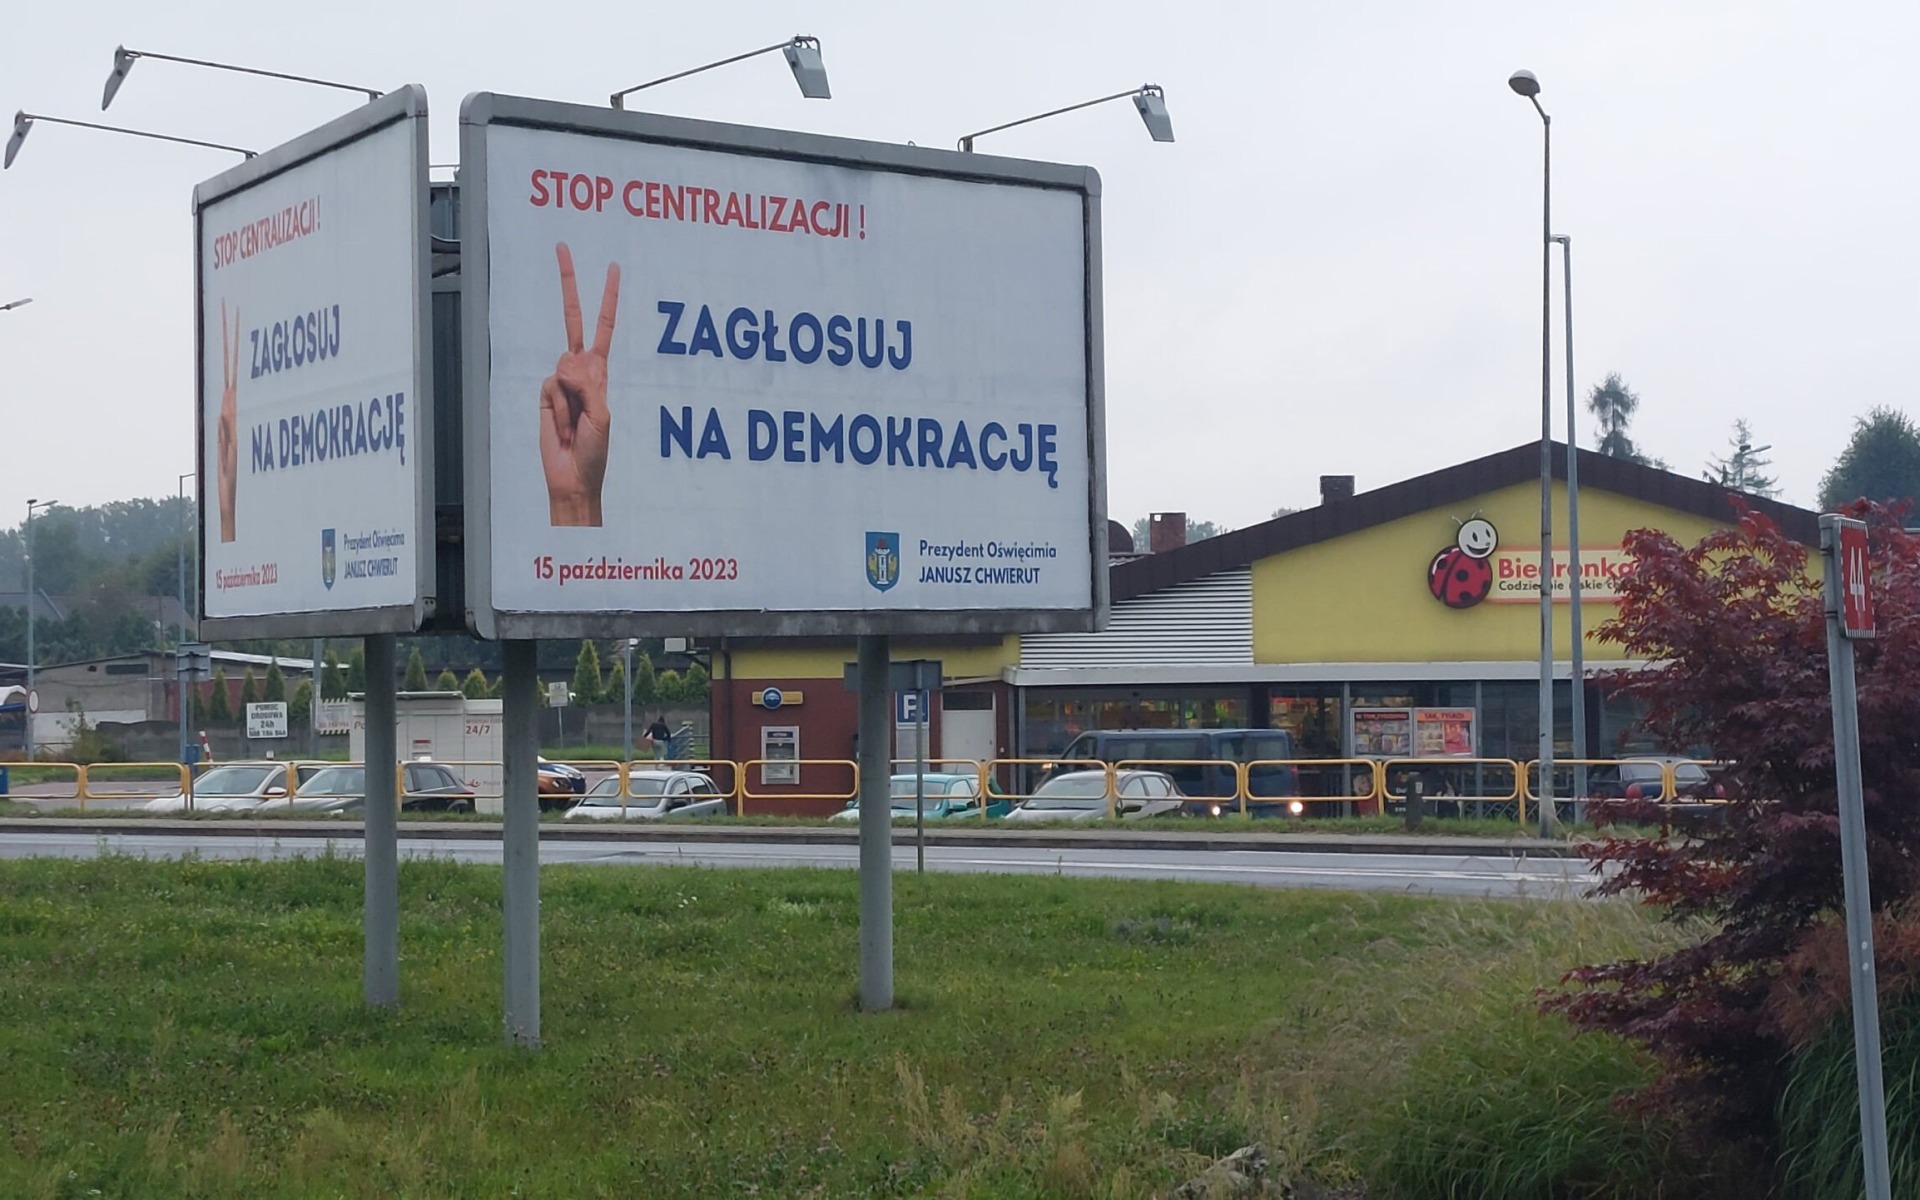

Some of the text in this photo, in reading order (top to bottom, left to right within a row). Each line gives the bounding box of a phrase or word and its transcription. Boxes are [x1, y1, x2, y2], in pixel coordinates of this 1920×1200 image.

[530, 169, 866, 240] STOP CENTRALIZACJI !
[214, 230, 239, 270] STOP
[240, 198, 315, 259] CENTRALIZACJI
[251, 304, 340, 379] ZAGŁOSUJ
[657, 301, 912, 370] ZAGŁOSUJ
[252, 392, 405, 474] NA DEMOKRACJĘ
[660, 405, 1059, 489] NA DEMOKRACJĘ
[344, 531, 372, 555] Prezydent
[919, 540, 1057, 562] Prezydent Oświęcimia
[215, 569, 223, 589] 15
[262, 563, 278, 585] 2023
[344, 560, 366, 579] JANUSZ
[533, 556, 738, 586] 15 października 2023
[919, 566, 1040, 584] JANUSZ CHWIERUT
[1849, 546, 1866, 611] 44
[1499, 580, 1564, 591] Codzieie
[1569, 579, 1602, 590] skie
[466, 725, 491, 736] 24/7
